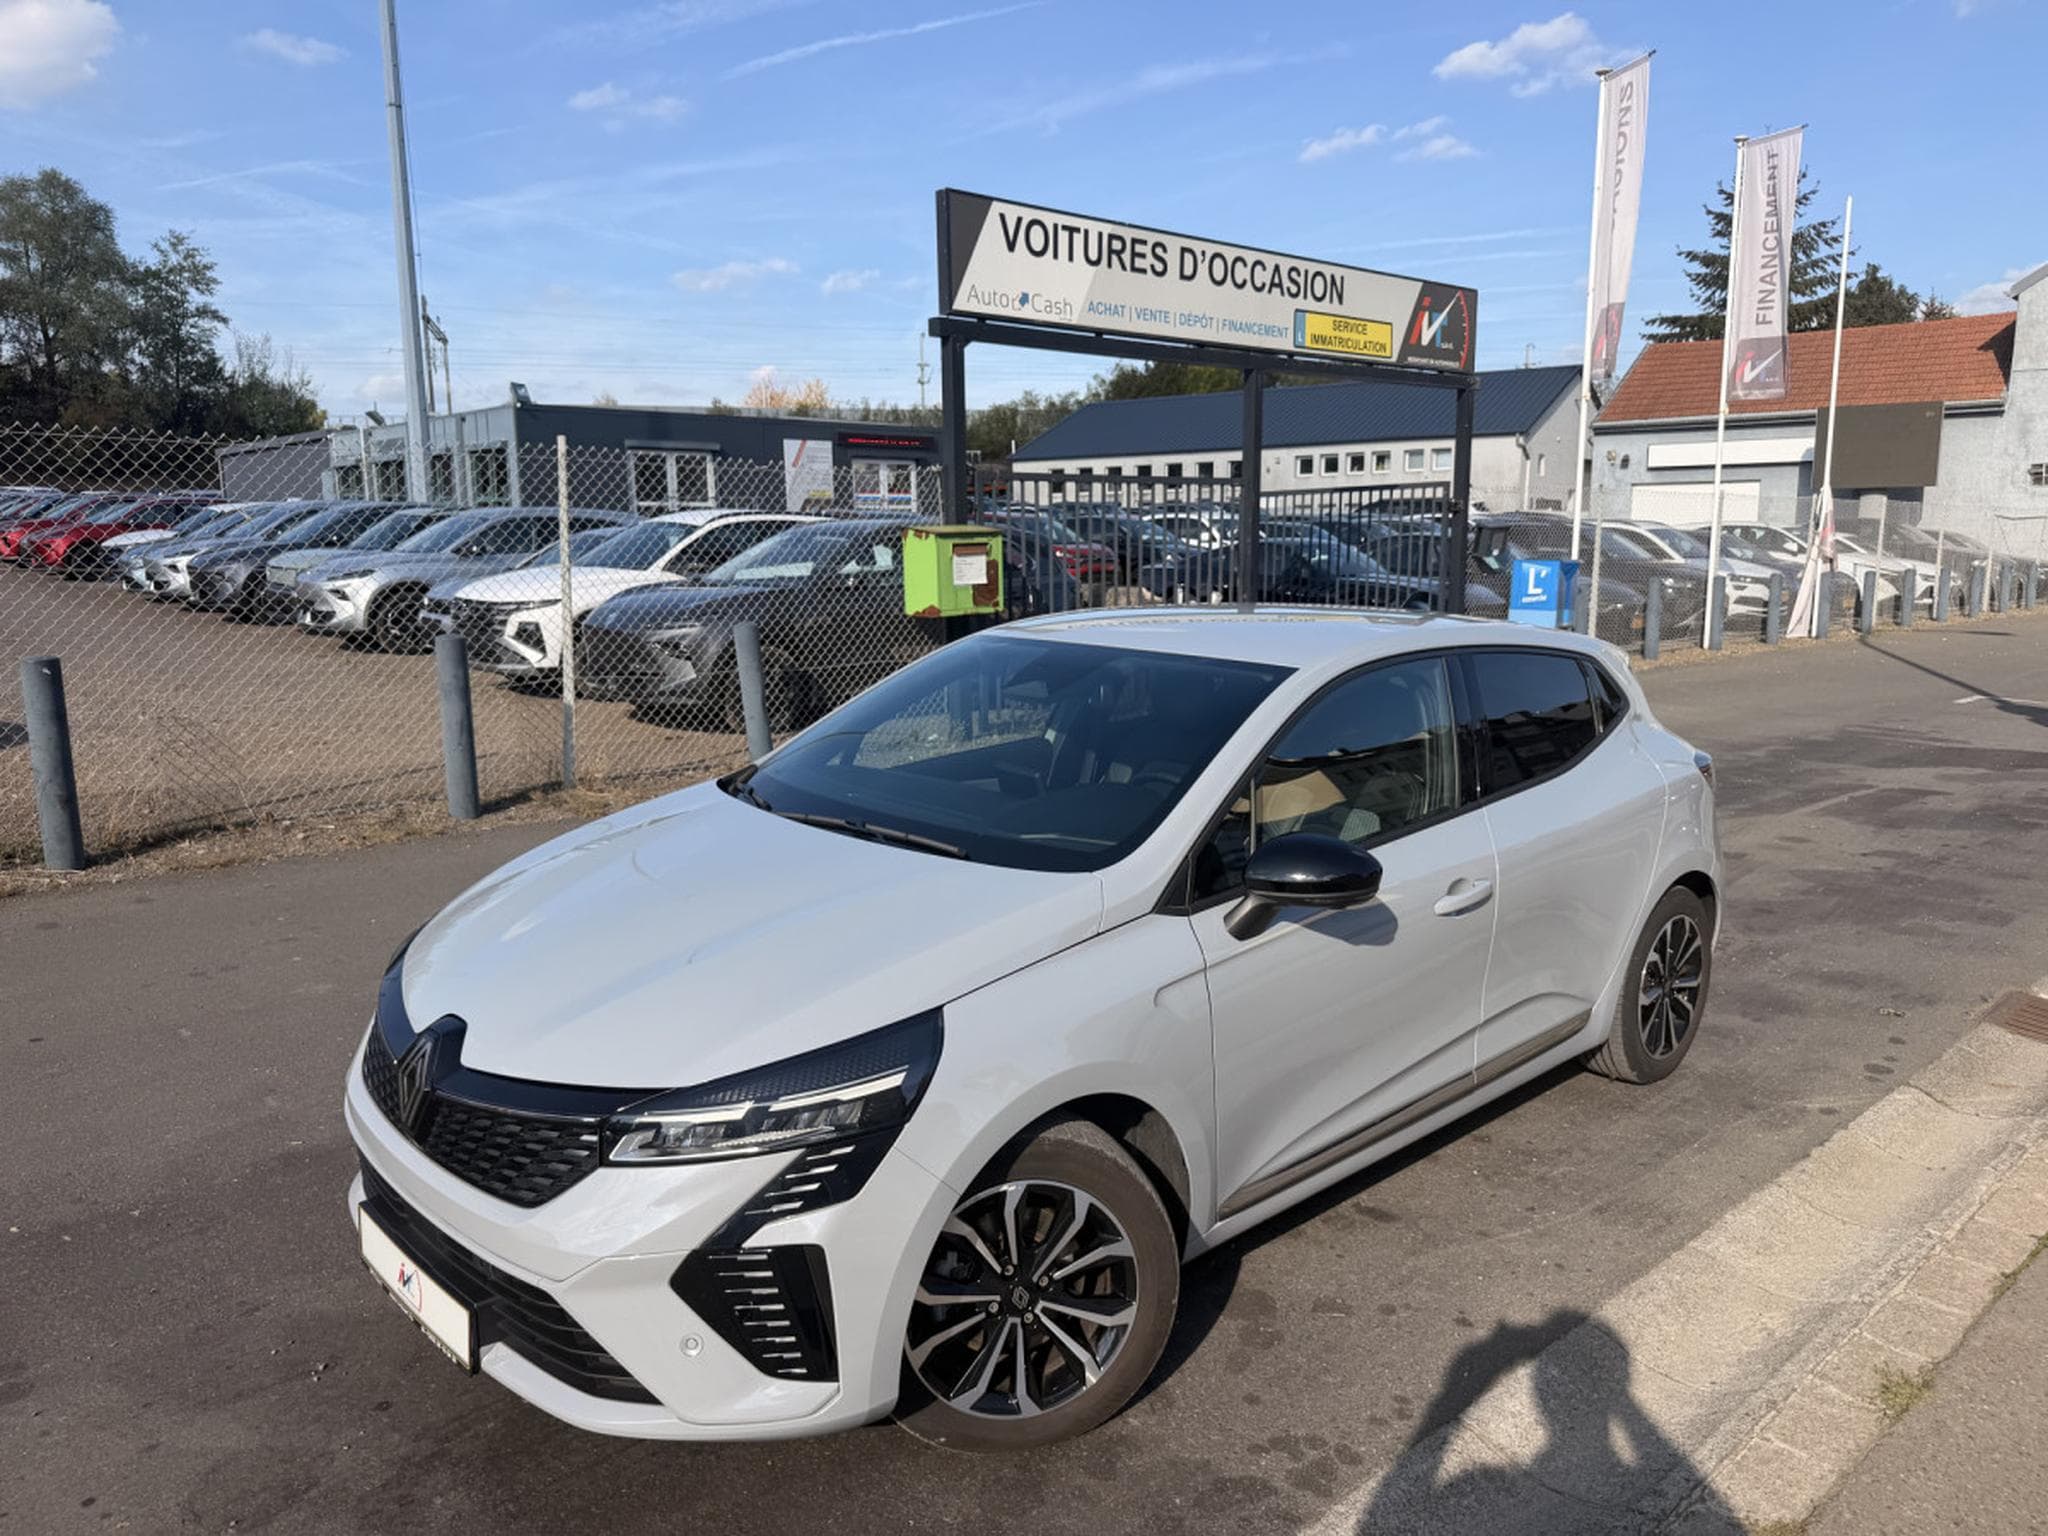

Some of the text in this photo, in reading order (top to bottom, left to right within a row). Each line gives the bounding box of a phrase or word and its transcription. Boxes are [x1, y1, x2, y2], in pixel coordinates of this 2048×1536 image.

[1755, 149, 1779, 326] FINANCEMENT
[999, 212, 1345, 305] VOITURES D'OCCASION
[1087, 301, 1126, 318] ACHAT
[1135, 308, 1170, 324] VENTE
[1221, 319, 1289, 338] FINANCEMENT
[1332, 319, 1367, 336] SERVICE
[1310, 333, 1387, 353] IMMATRICULATION
